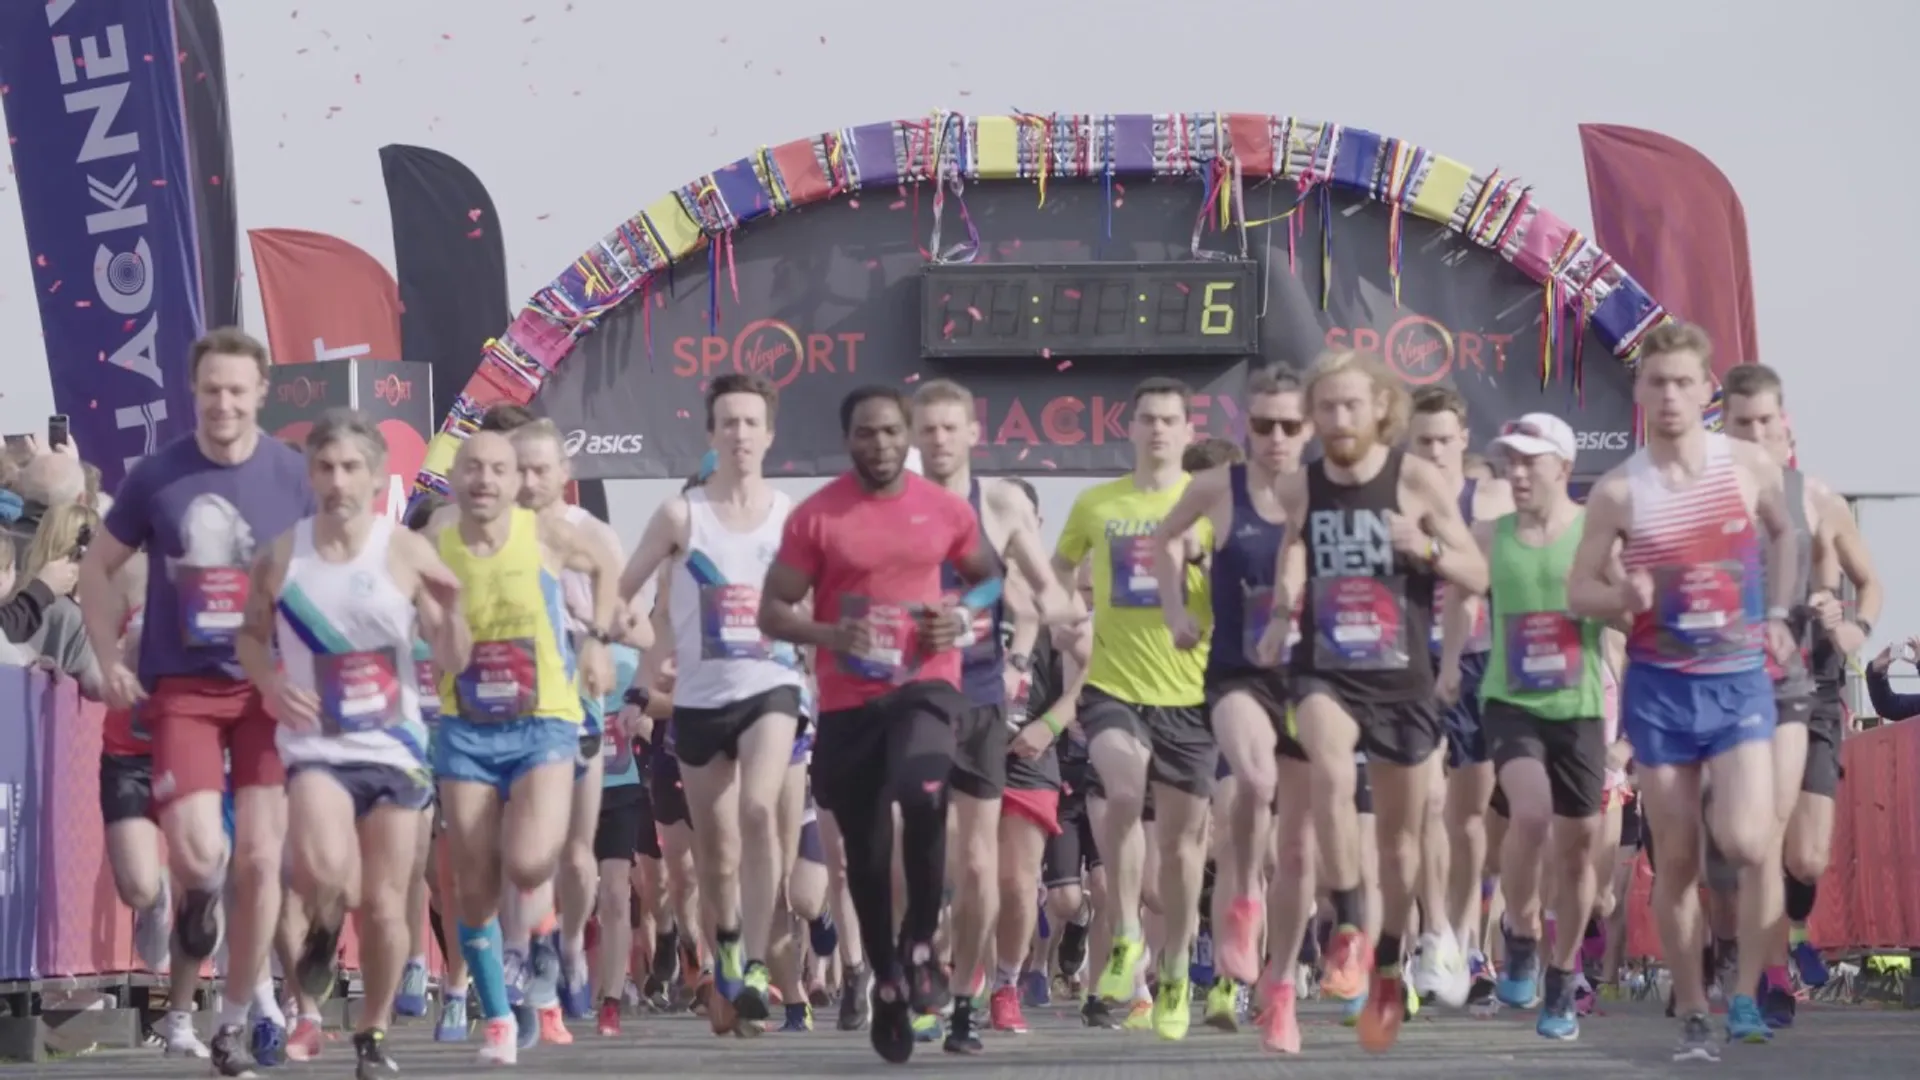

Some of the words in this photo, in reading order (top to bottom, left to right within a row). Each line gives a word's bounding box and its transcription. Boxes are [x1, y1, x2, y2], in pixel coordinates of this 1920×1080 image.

[1200, 281, 1236, 335] 6
[673, 318, 866, 390] SPORT
[745, 334, 792, 375] Virgin
[1396, 329, 1442, 371] Virgin
[374, 373, 412, 406] SPORT
[1311, 508, 1393, 544] RUN
[1315, 543, 1394, 577] DEM
